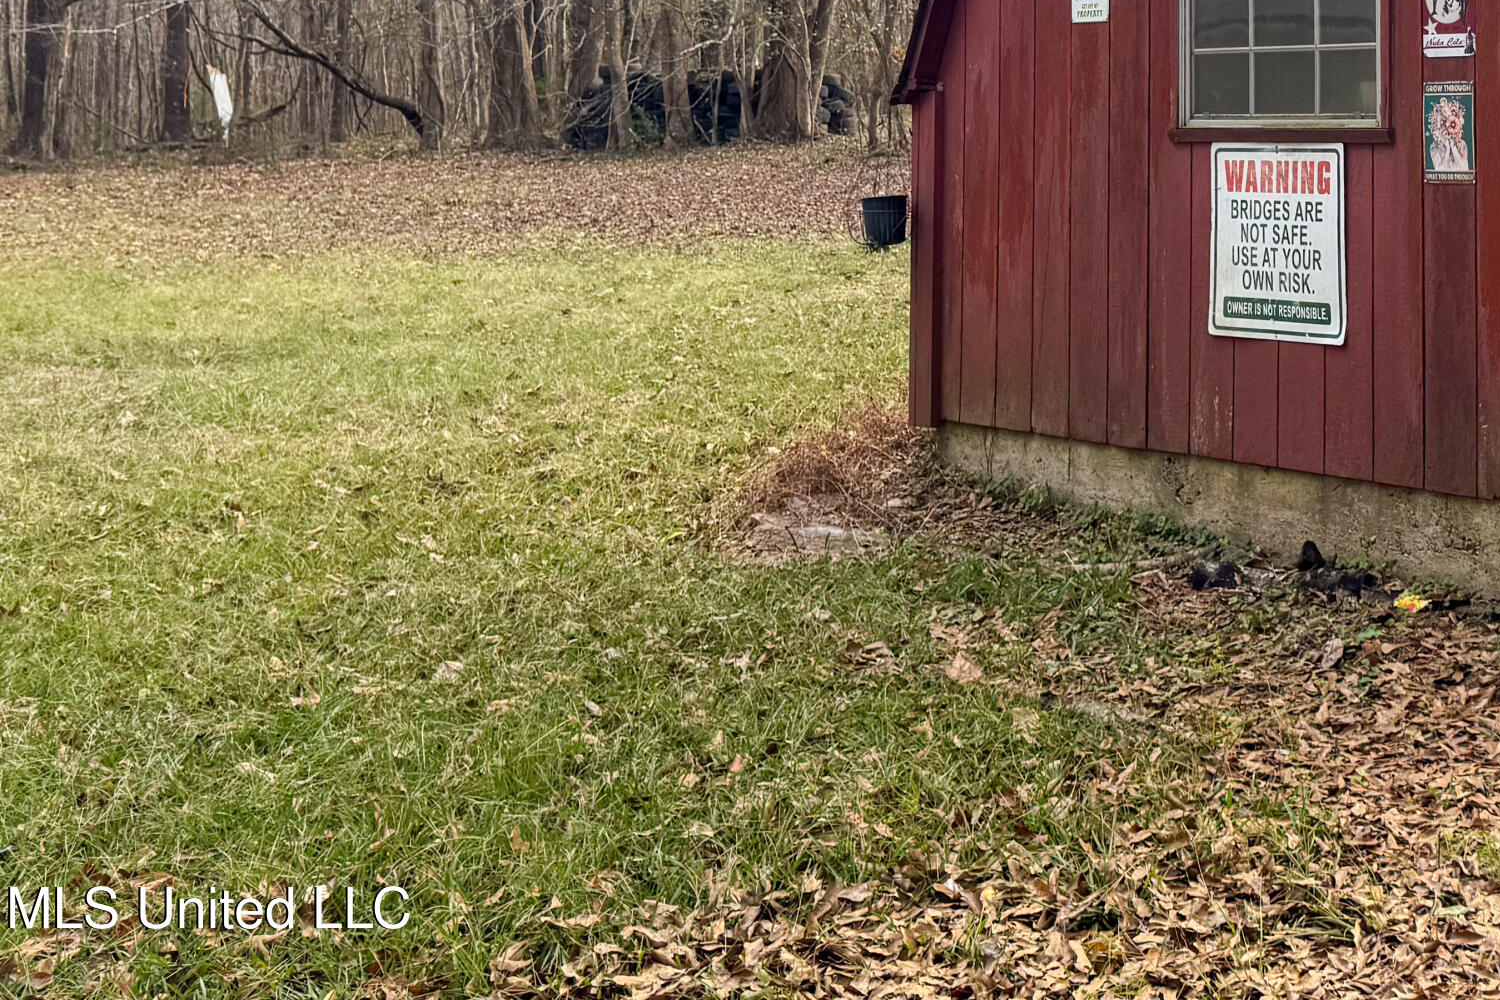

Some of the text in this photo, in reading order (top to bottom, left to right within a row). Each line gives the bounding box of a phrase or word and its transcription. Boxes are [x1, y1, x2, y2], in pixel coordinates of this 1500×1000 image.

[1444, 84, 1472, 92] THROUGH
[1224, 159, 1331, 195] WARNING
[1231, 199, 1323, 222] BRIDGES ARE
[1240, 223, 1312, 246] NOT SAFE.
[1232, 246, 1322, 270] USE AT YOUR
[1242, 269, 1315, 294] OWN RISK.
[1227, 301, 1329, 320] OWNER IS NOT RESPONSIBLE.
